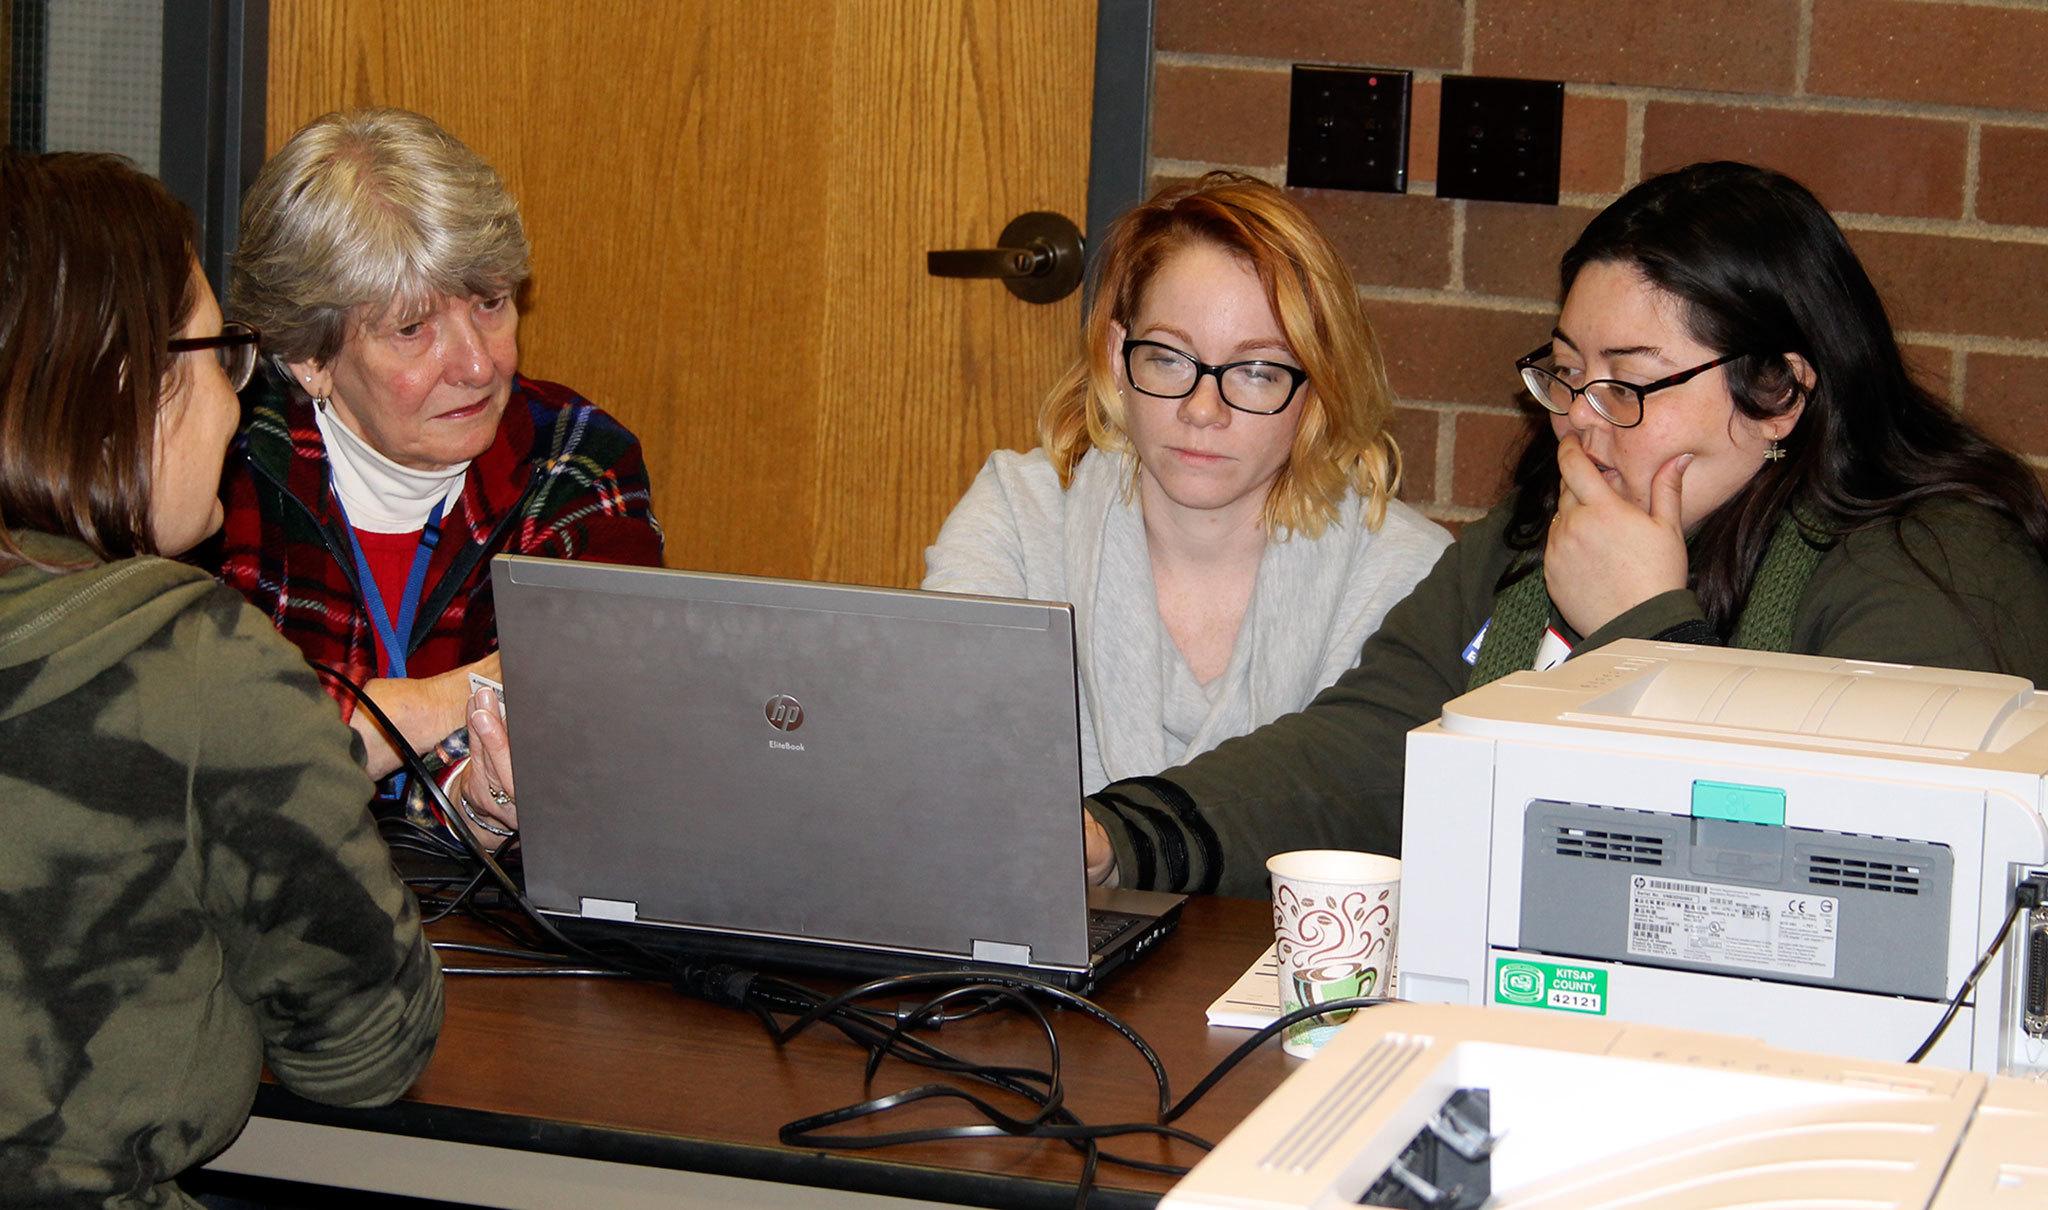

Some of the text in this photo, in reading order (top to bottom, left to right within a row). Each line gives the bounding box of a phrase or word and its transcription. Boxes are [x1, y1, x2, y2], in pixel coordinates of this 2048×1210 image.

[766, 694, 803, 731] hp
[769, 740, 805, 752] EliteBook
[1556, 968, 1595, 981] KITSAP
[1553, 979, 1597, 993] COUNTY
[1553, 994, 1597, 1008] 42121
